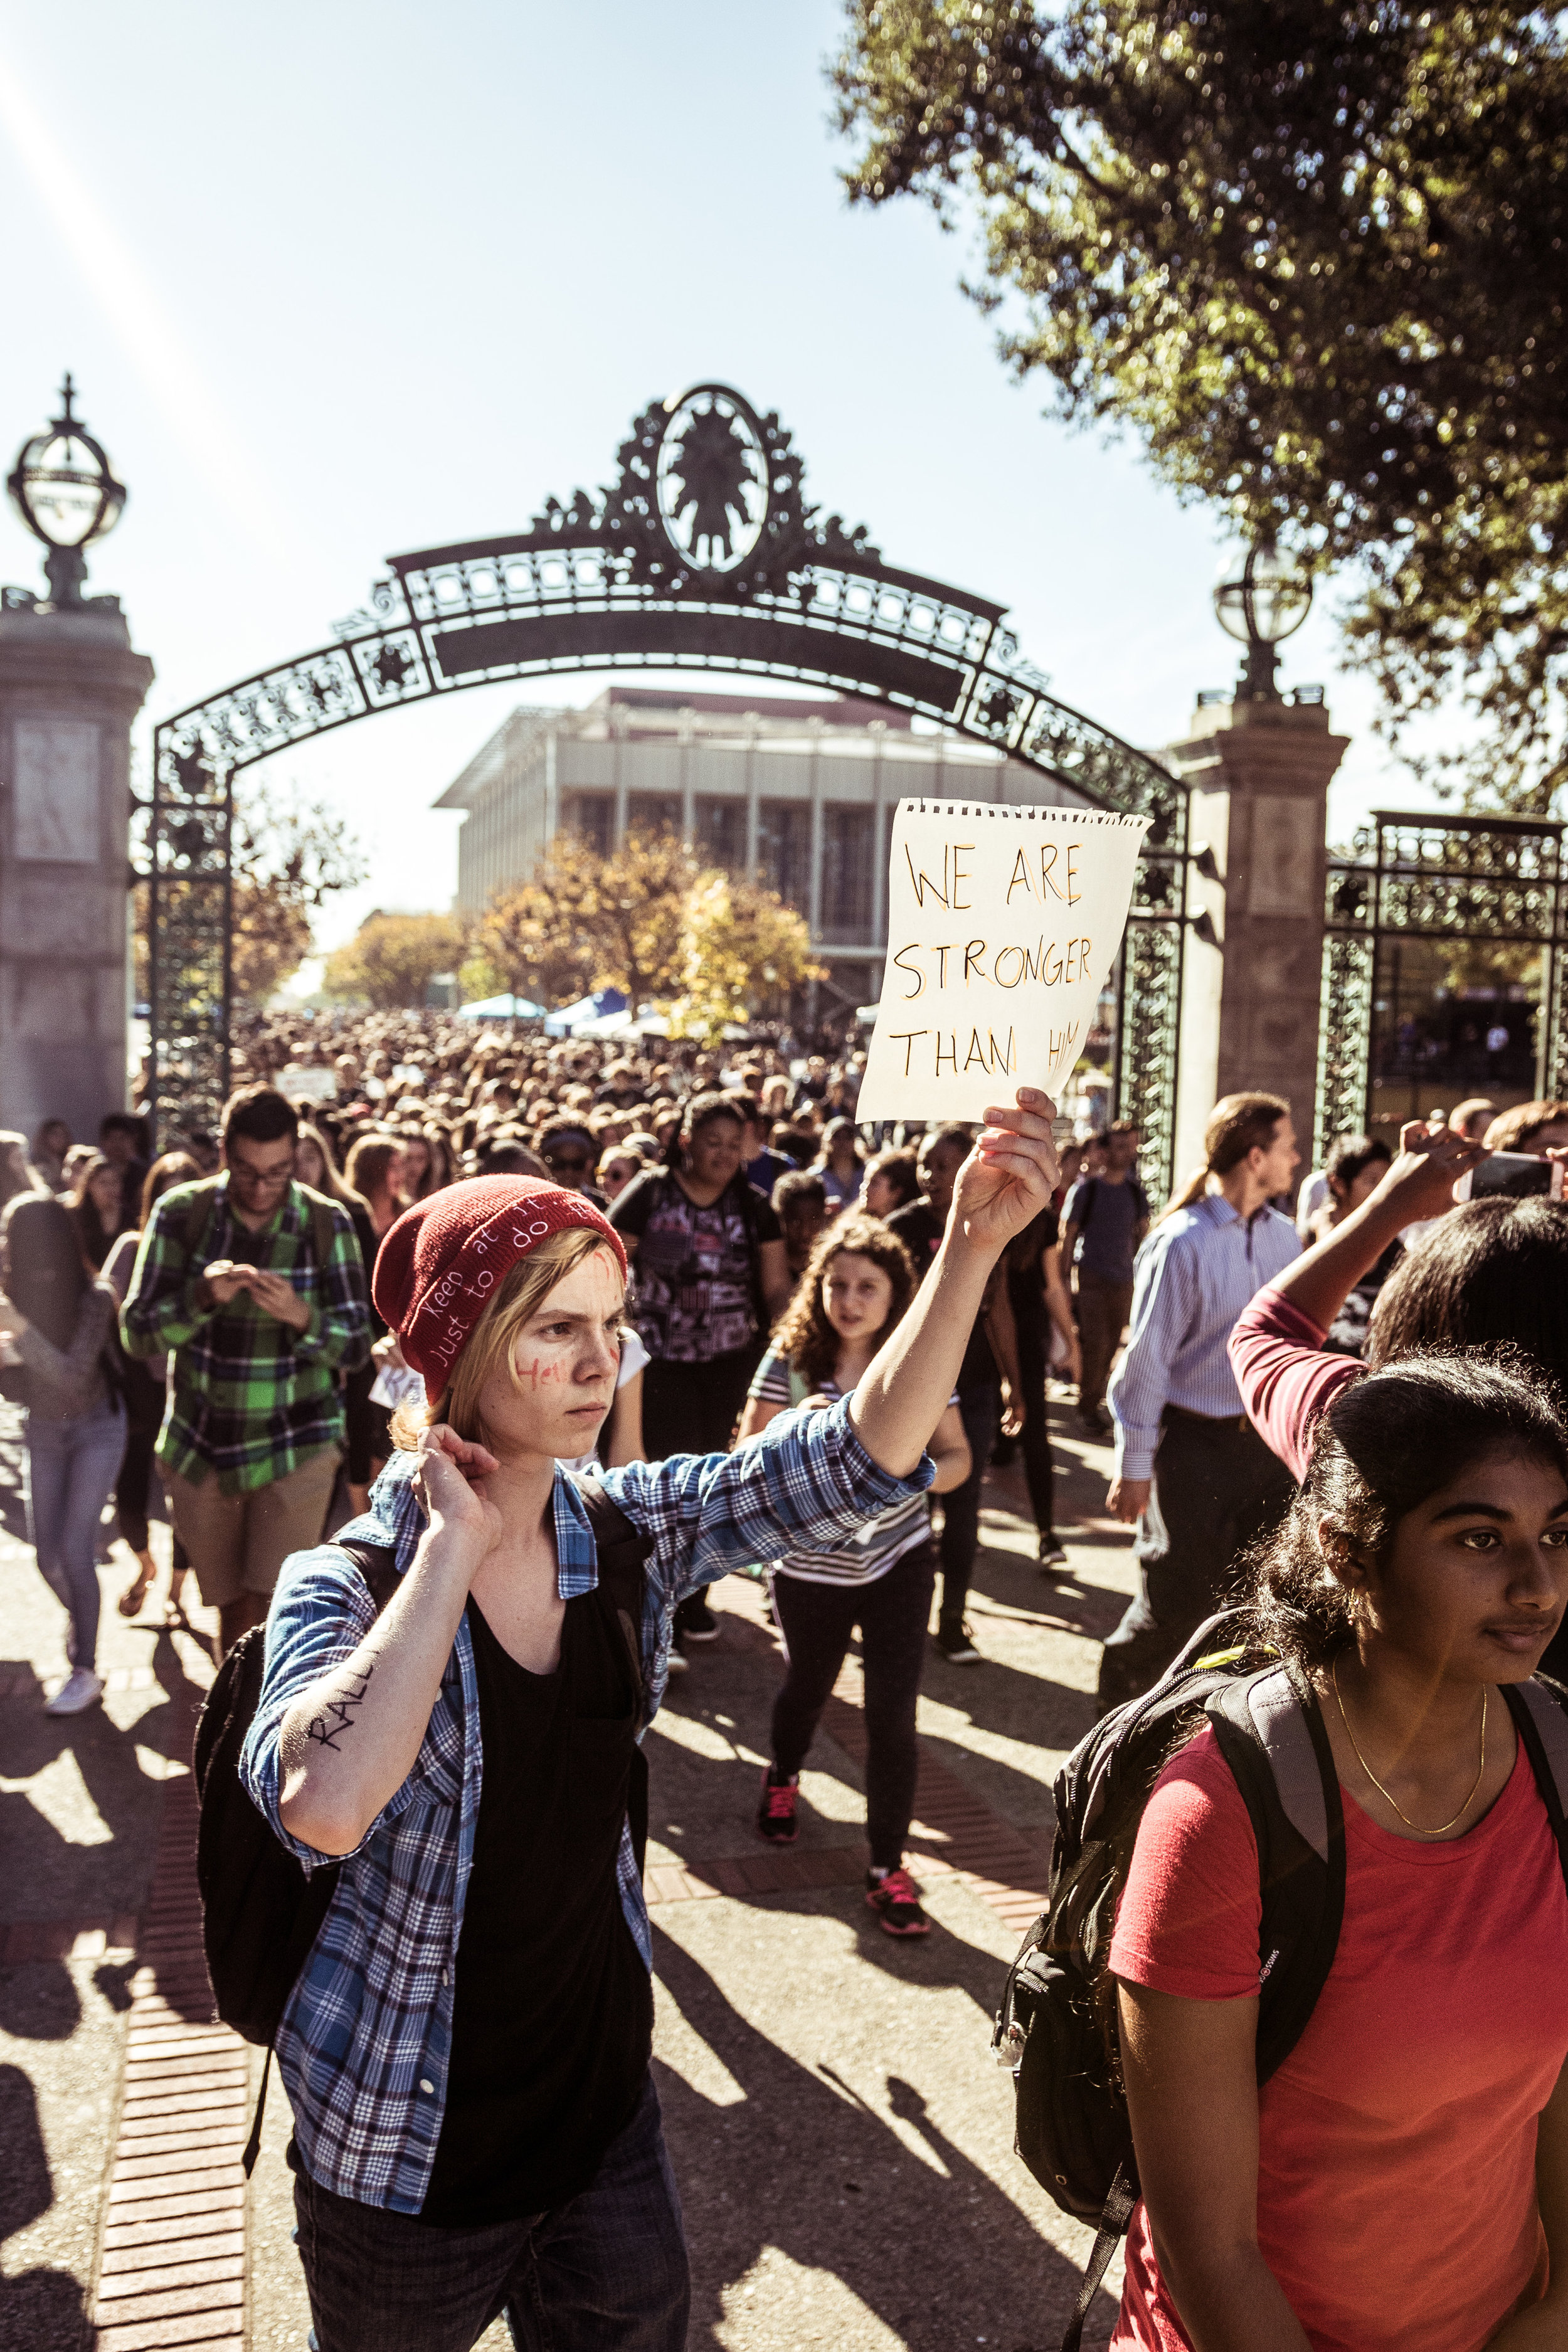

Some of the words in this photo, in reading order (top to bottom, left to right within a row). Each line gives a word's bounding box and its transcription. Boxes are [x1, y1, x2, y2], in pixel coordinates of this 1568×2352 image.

[904, 842, 975, 911] WE
[1007, 843, 1084, 907] ARE
[893, 935, 1092, 1000] STRONGER
[889, 1025, 1017, 1077] THAN
[421, 1271, 464, 1319] Keep
[472, 1229, 499, 1254] at
[430, 1315, 470, 1368] Just
[464, 1270, 494, 1298] to
[512, 1221, 549, 1248] do
[1264, 1949, 1279, 1969] SWISS
